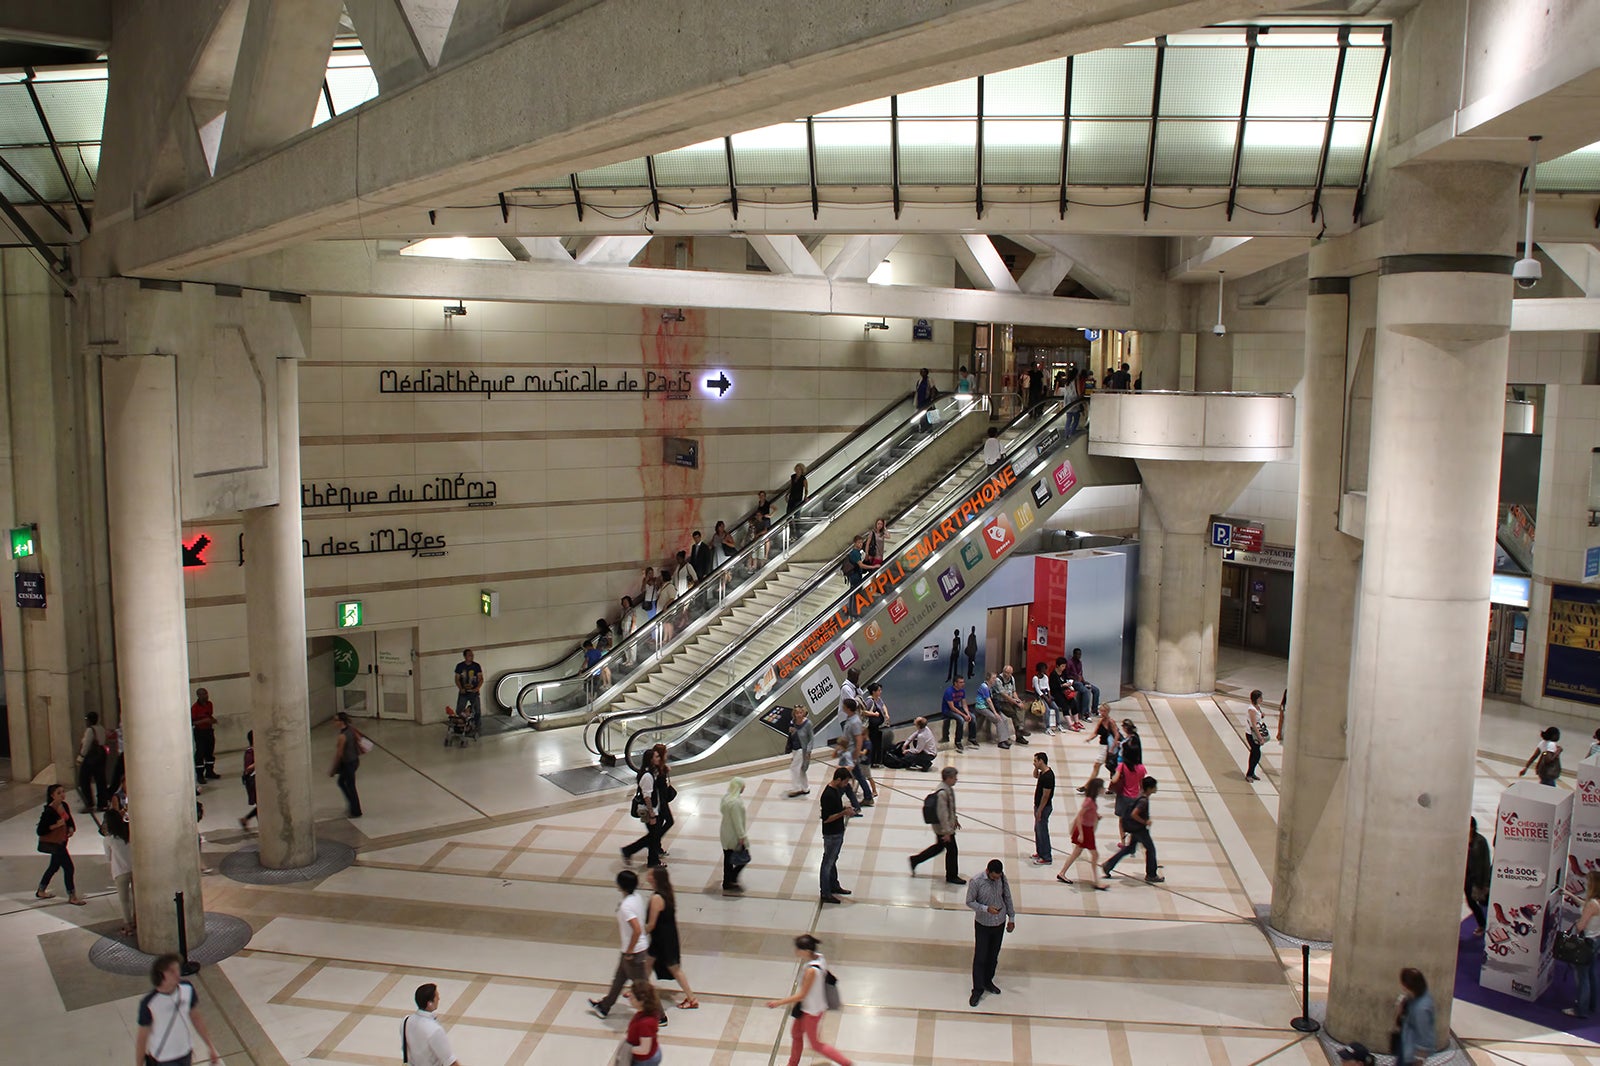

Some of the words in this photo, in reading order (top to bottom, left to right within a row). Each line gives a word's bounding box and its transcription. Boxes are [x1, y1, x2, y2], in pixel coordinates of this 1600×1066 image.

[1090, 330, 1098, 339] B
[380, 367, 516, 399] Médiathèque
[525, 366, 608, 392] musicale
[617, 371, 638, 391] de
[645, 370, 692, 398] Paris
[301, 482, 378, 513] thèque
[388, 484, 413, 502] du
[423, 472, 497, 500] cinéma
[321, 536, 360, 555] des
[855, 558, 907, 616] APPLI
[905, 464, 1018, 570] SMARTPHONE
[1217, 527, 1227, 542] P
[779, 623, 840, 679] GRATUITEMENT
[806, 675, 831, 698] forum
[810, 682, 834, 705] Halles
[1503, 826, 1549, 839] RENTRÉE
[1503, 866, 1514, 875] de
[1515, 867, 1538, 877] 500€
